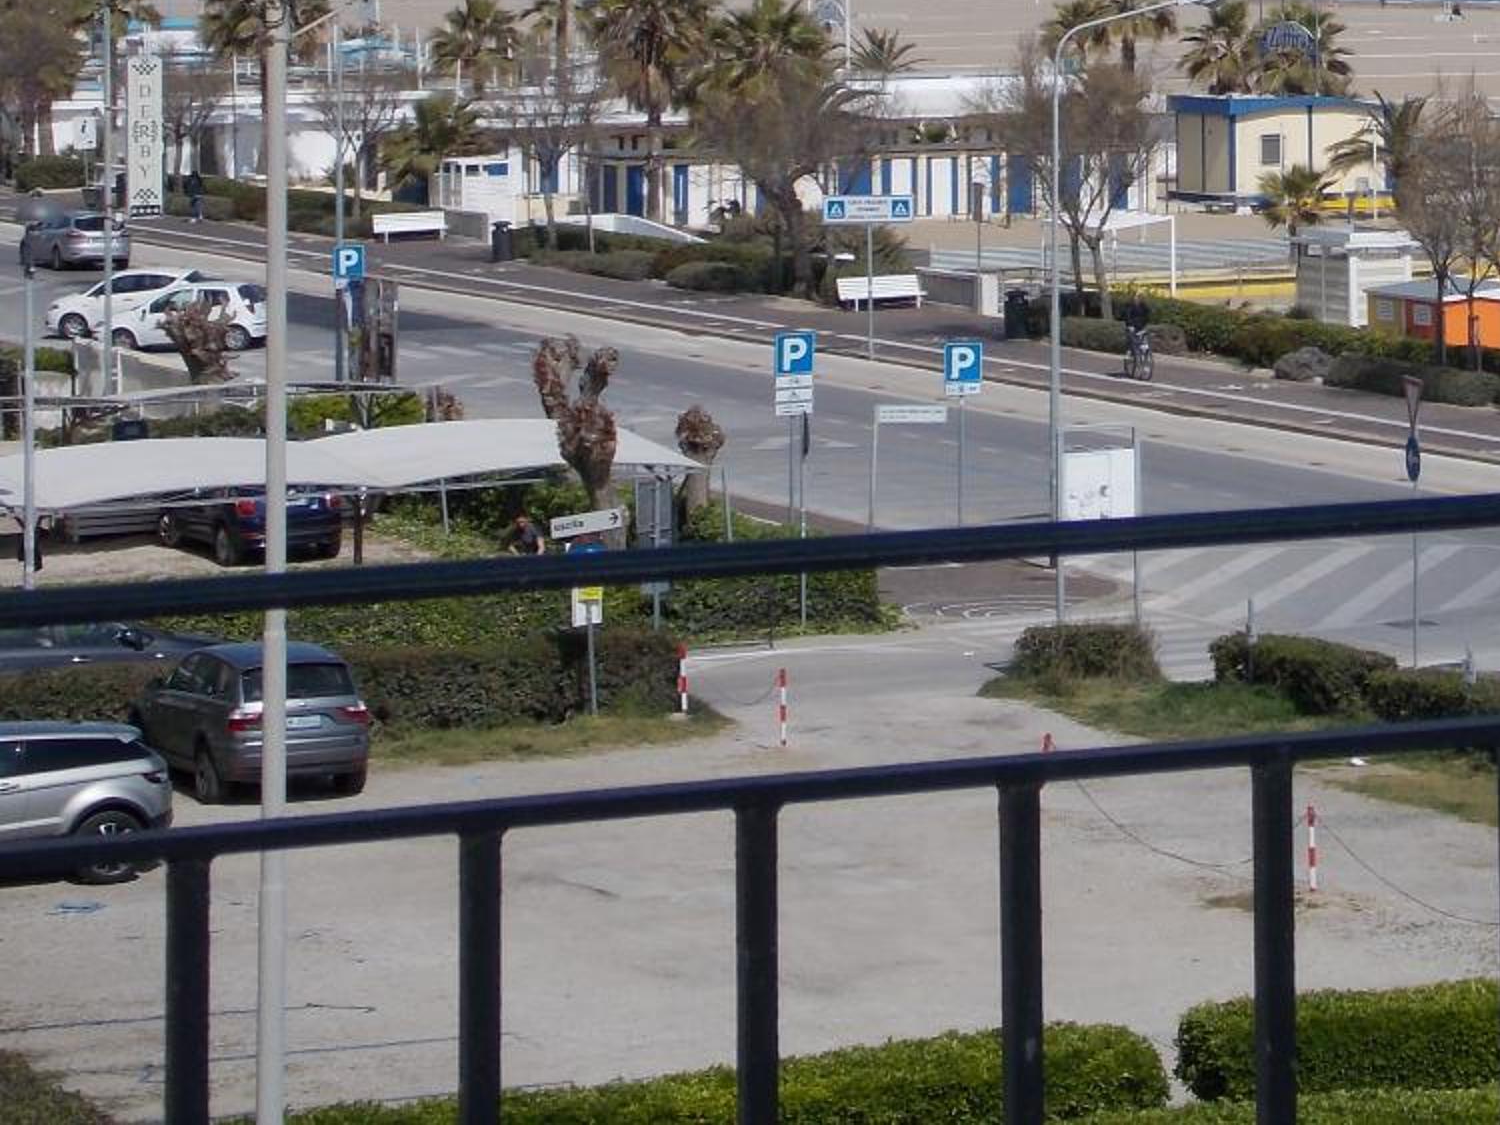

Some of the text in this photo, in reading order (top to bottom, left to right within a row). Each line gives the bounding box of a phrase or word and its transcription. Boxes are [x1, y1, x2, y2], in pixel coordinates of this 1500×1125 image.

[139, 82, 152, 180] DERBY
[339, 248, 359, 276] P
[782, 337, 808, 372] P
[950, 346, 976, 380] P
